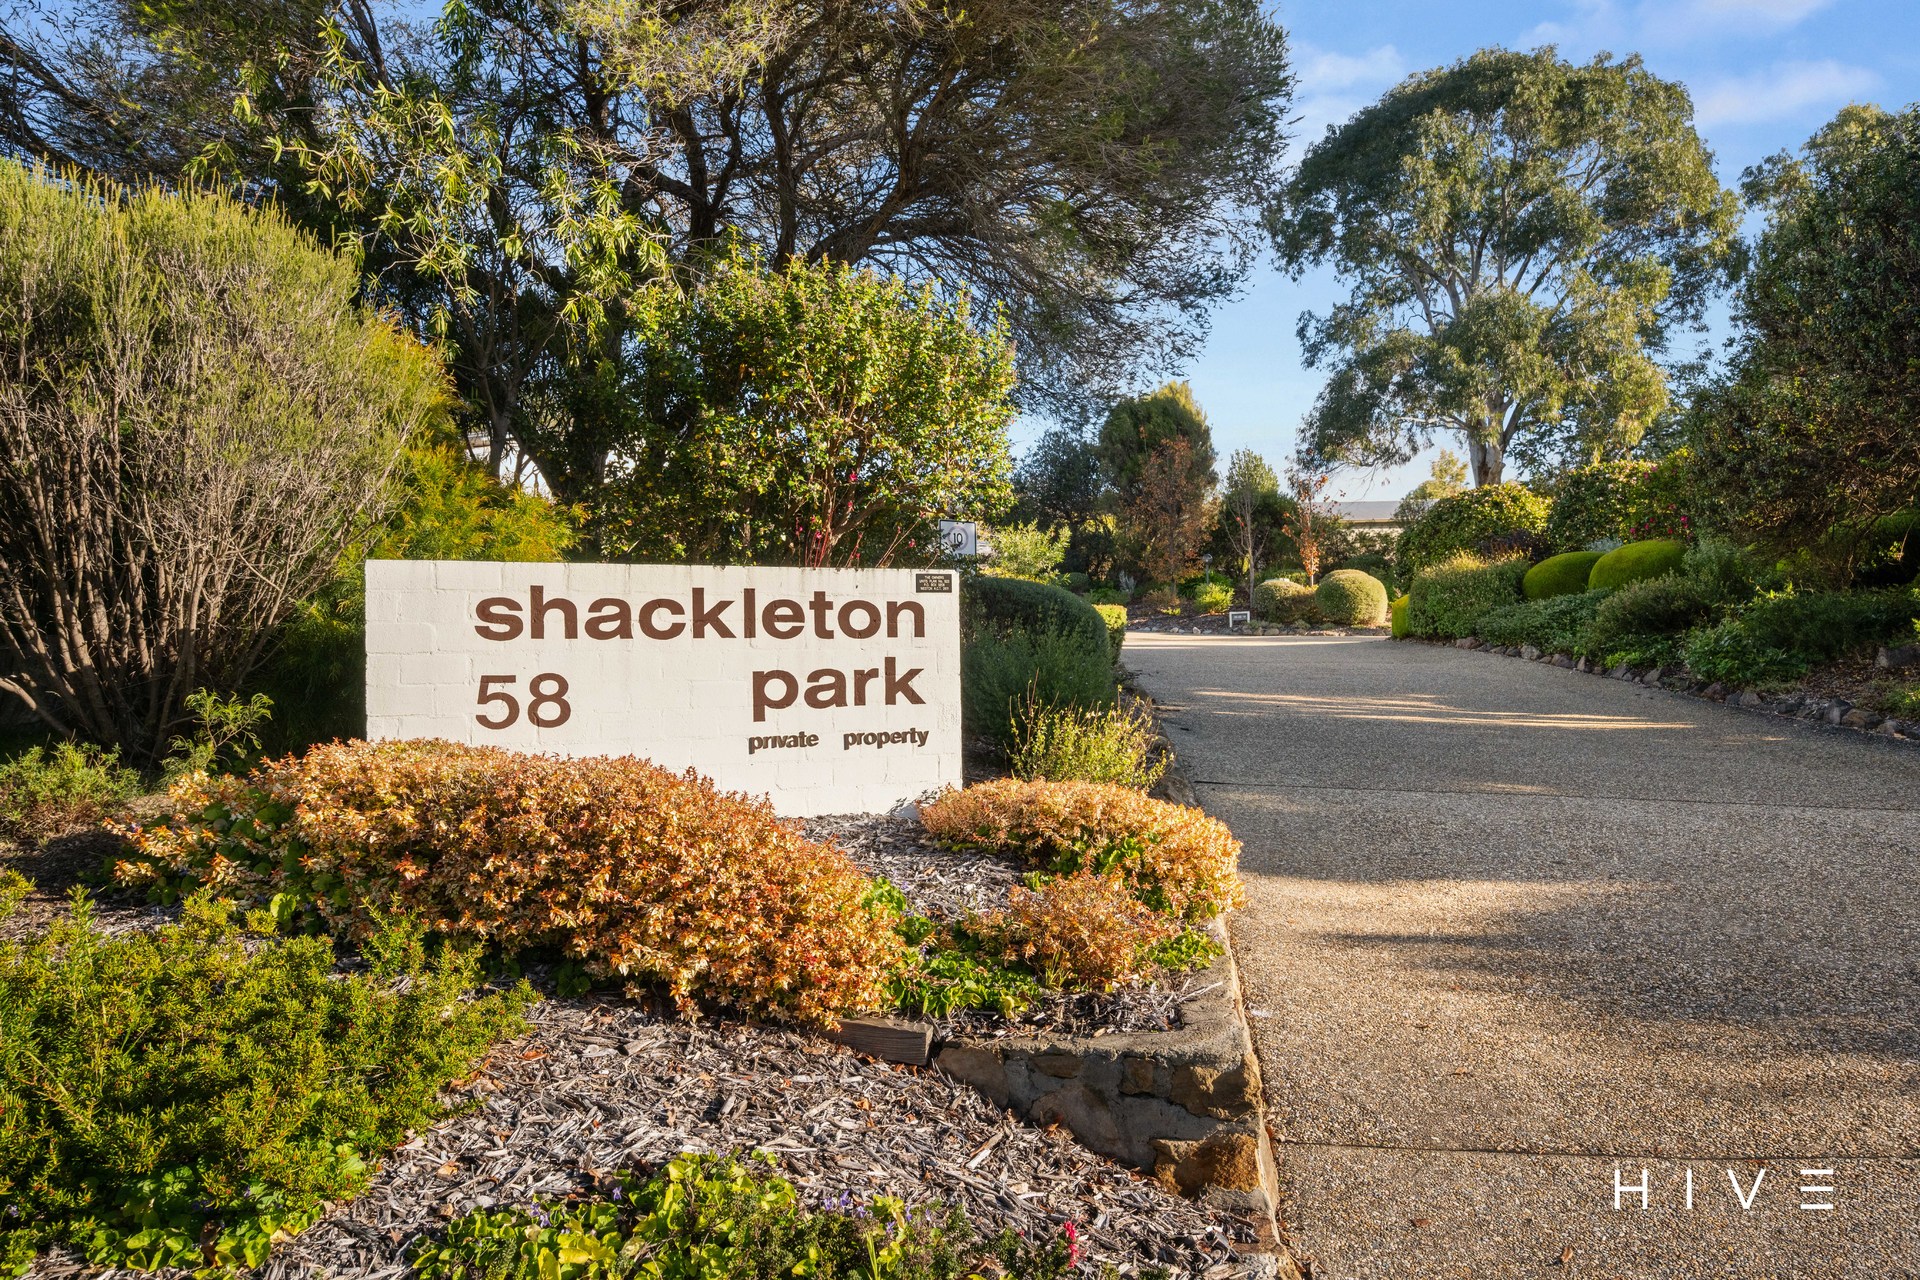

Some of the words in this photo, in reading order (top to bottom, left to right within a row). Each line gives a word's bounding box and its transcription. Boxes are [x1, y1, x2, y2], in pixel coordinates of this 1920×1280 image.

[953, 532, 963, 544] 10
[474, 584, 926, 642] shackleton
[475, 672, 572, 730] 58
[752, 656, 927, 723] park
[748, 731, 820, 755] private
[843, 727, 930, 751] property
